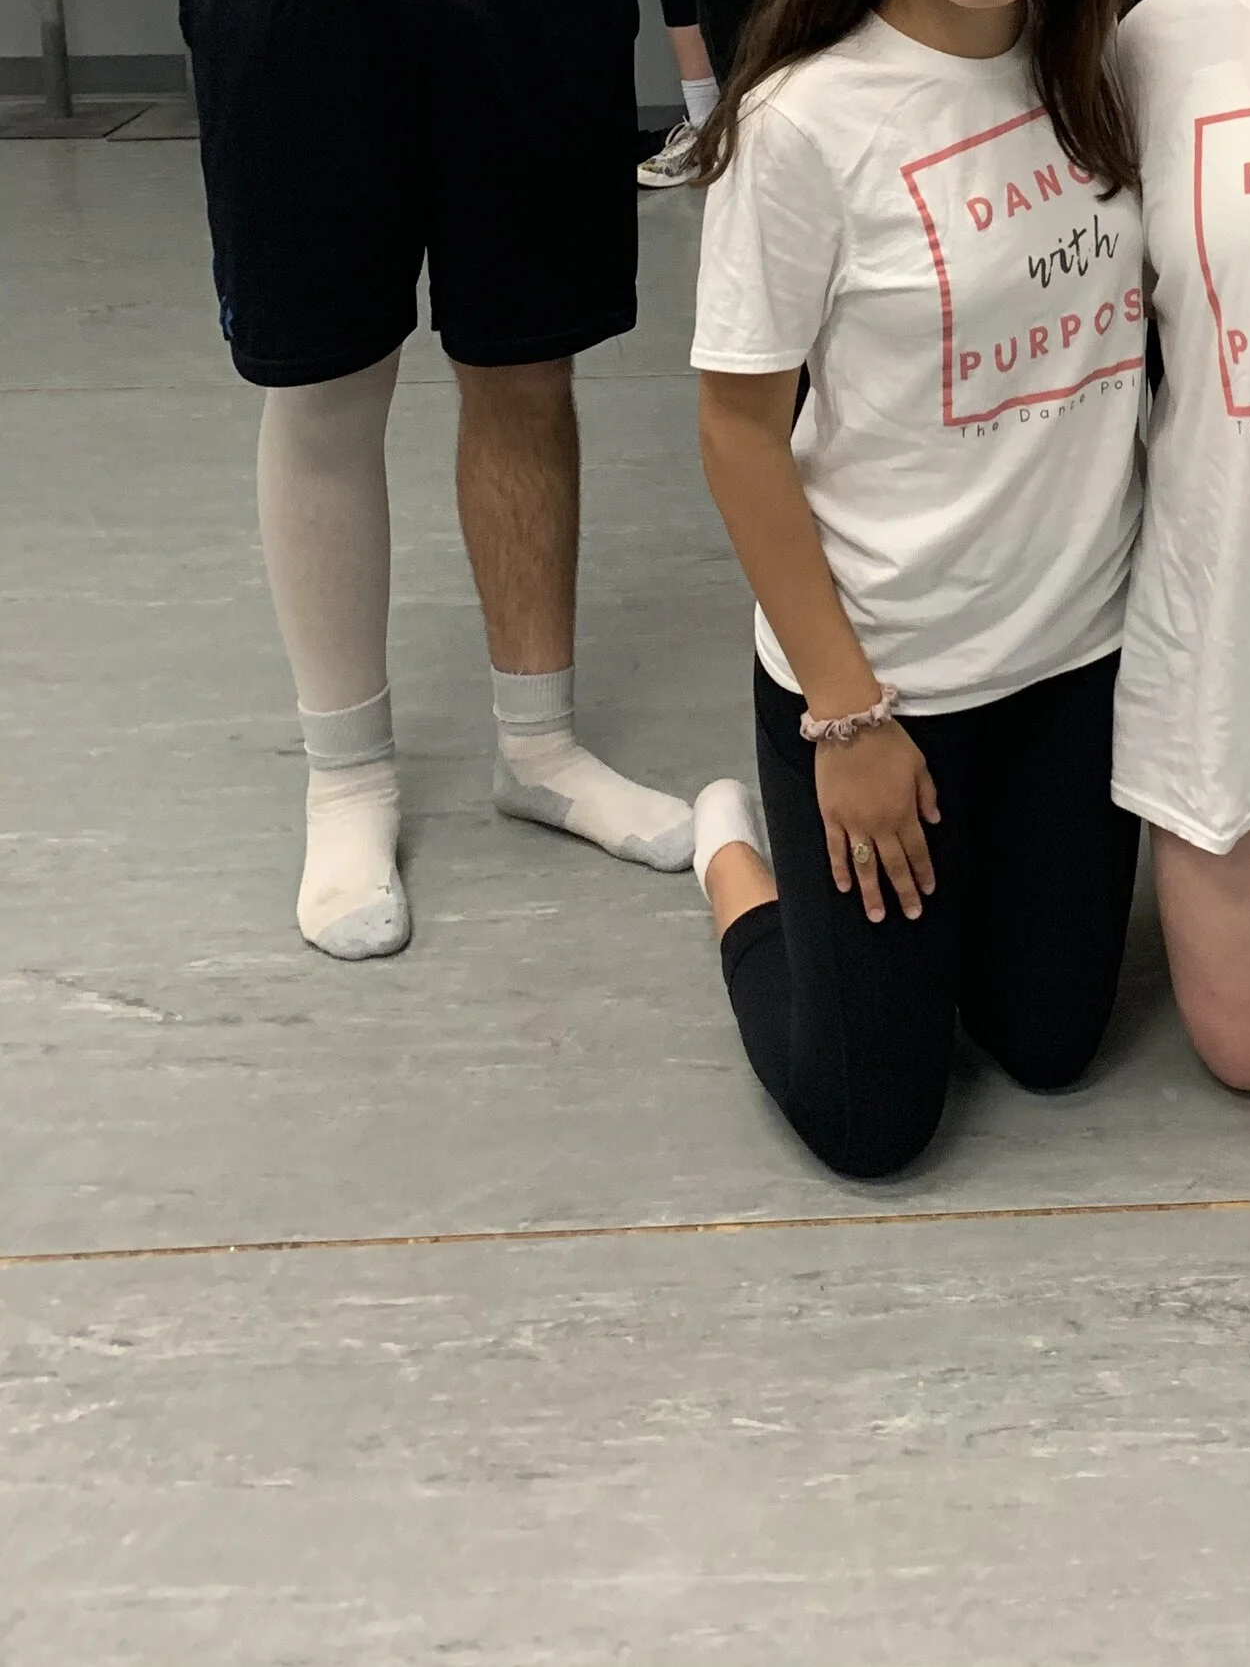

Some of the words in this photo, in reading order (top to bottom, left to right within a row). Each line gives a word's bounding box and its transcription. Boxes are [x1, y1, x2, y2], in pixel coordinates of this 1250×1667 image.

[966, 159, 1094, 231] DANC
[1028, 214, 1119, 288] with
[960, 288, 1141, 380] PURPOS
[961, 422, 999, 439] The
[1019, 394, 1086, 423] Dance
